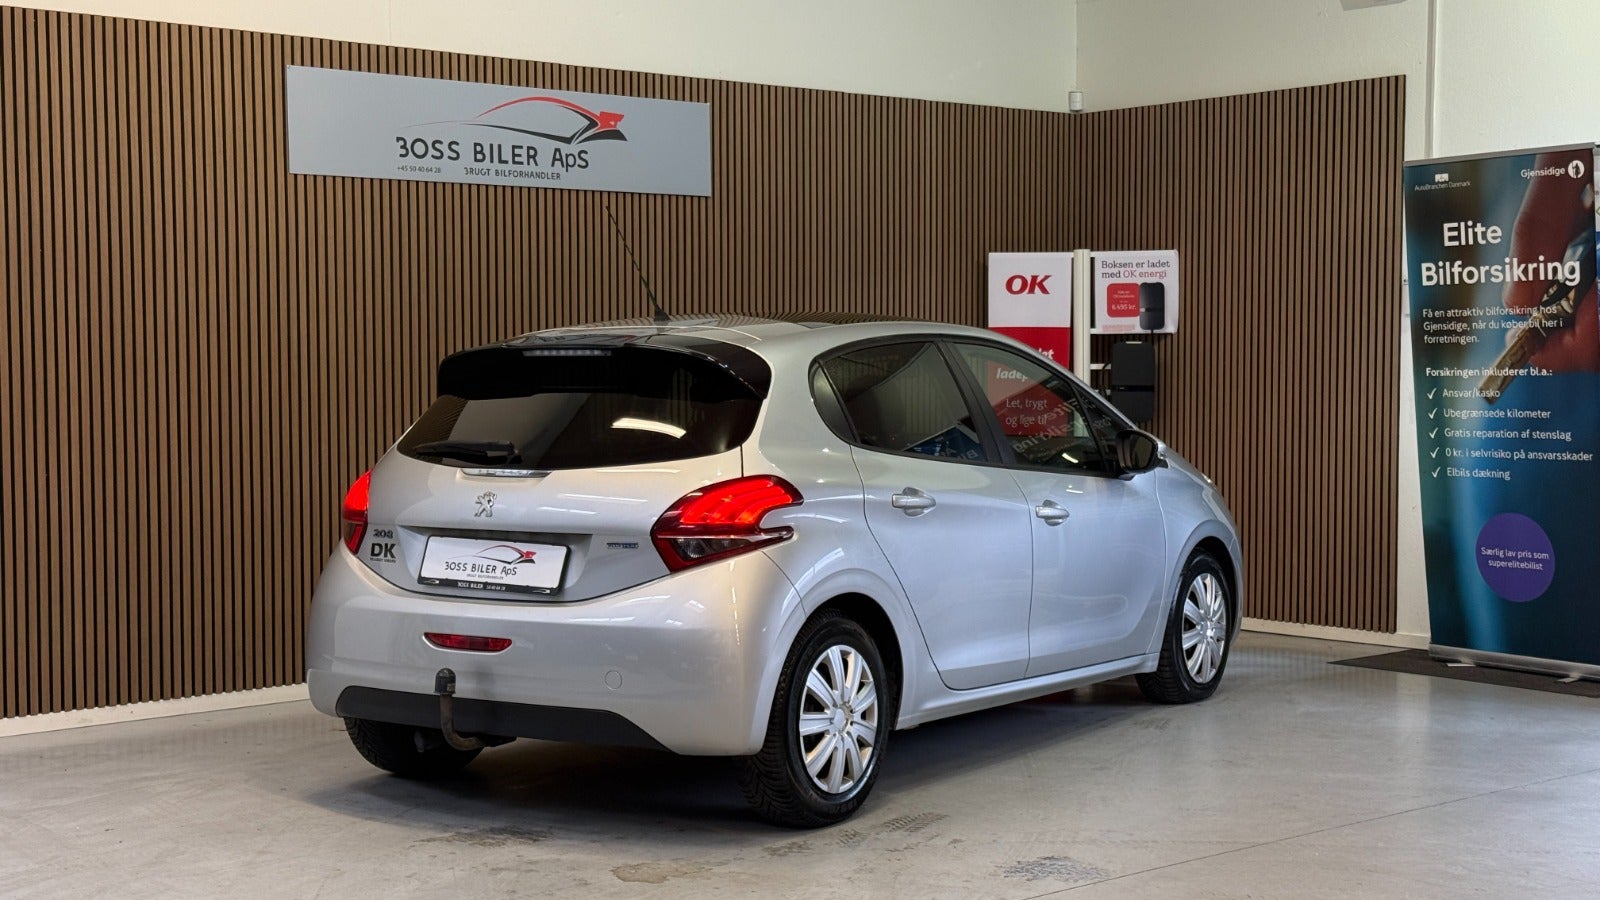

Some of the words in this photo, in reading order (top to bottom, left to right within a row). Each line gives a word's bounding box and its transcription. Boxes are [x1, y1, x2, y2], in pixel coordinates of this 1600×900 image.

[473, 142, 539, 167] BILER
[551, 147, 590, 173] ApS
[495, 169, 561, 181] BILFORHANDLER
[1520, 166, 1566, 178] Gjensidige
[1443, 220, 1503, 247] Elite
[1101, 260, 1134, 269] Boksen
[1147, 259, 1171, 268] ladet
[1101, 270, 1121, 278] med
[1123, 269, 1137, 278] OK
[1139, 270, 1167, 279] energi
[1421, 255, 1581, 287] Bilforsikring
[1005, 274, 1052, 295] OK
[1422, 308, 1433, 318] Få
[1434, 310, 1445, 318] en
[1446, 307, 1484, 318] attraktiv
[1485, 305, 1538, 317] bilforsikring
[1540, 305, 1557, 314] hos
[1423, 321, 1470, 332] Gjensidige,
[1472, 320, 1487, 330] når
[1488, 320, 1499, 329] du
[1501, 319, 1526, 329] køber
[1529, 319, 1540, 328] bil
[1541, 318, 1558, 328] her
[1424, 334, 1480, 345] forretningen.
[1425, 367, 1480, 379] Forsikringen
[1481, 367, 1529, 377] inkluderer
[1442, 387, 1501, 398] Ansvar/kasko
[1025, 399, 1048, 411] trygt
[1443, 409, 1505, 419] Ubegrænsede
[1507, 409, 1552, 419] kilometer
[1005, 416, 1017, 428] og
[1019, 414, 1035, 428] lige
[1037, 414, 1047, 425] til
[1444, 427, 1471, 438] Gratis
[1472, 429, 1519, 440] reparation
[1520, 428, 1530, 439] af
[1532, 430, 1572, 442] stenslag
[1453, 448, 1463, 457] kr.
[1470, 448, 1511, 459] selvrisiko
[1513, 449, 1525, 461] på
[1527, 451, 1593, 461] ansvarsskader
[1447, 467, 1471, 477] Elbils
[1472, 468, 1511, 481] dækning
[373, 529, 394, 539] 208
[370, 543, 396, 559] DK
[1480, 546, 1505, 558] Særlig
[1505, 548, 1517, 557] lav
[1518, 550, 1532, 559] pris
[1533, 552, 1549, 560] som
[471, 563, 497, 574] BILER
[500, 565, 518, 577] ApS
[1488, 559, 1544, 571] superelitebilist
